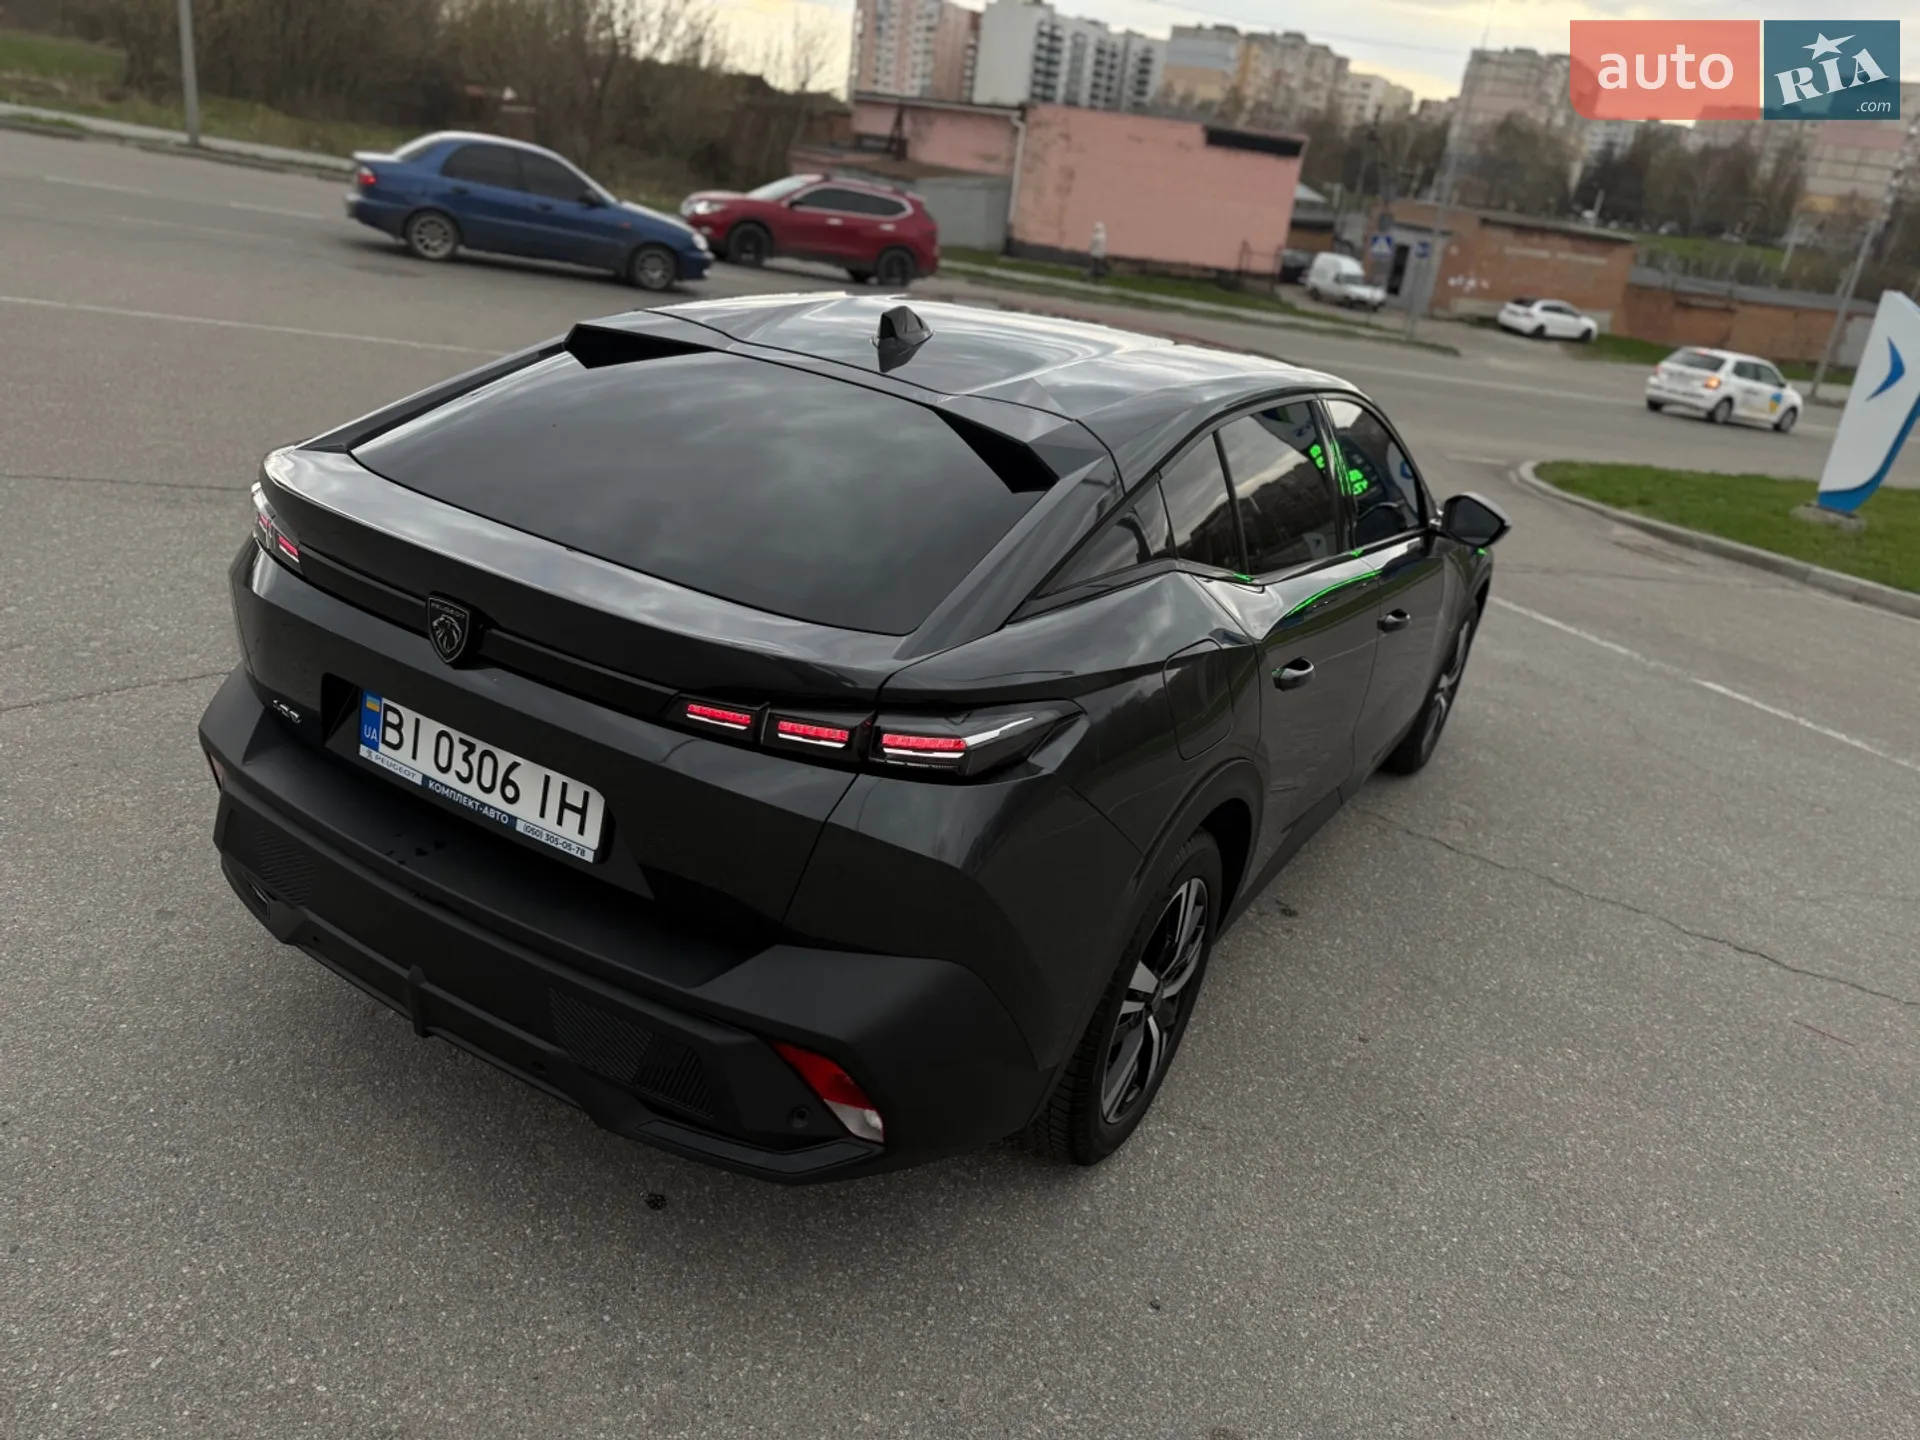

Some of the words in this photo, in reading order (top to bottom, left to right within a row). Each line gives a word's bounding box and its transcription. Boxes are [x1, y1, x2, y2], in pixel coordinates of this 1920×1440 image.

[363, 723, 378, 743] UA
[374, 752, 418, 780] PEUGEOT
[381, 703, 421, 761] BI
[434, 730, 522, 805] 0306
[539, 774, 590, 836] IH
[428, 780, 509, 824] КОМПЛЕКТ-АВТО
[522, 823, 543, 840] (050)
[544, 832, 586, 857] 305-05-78
